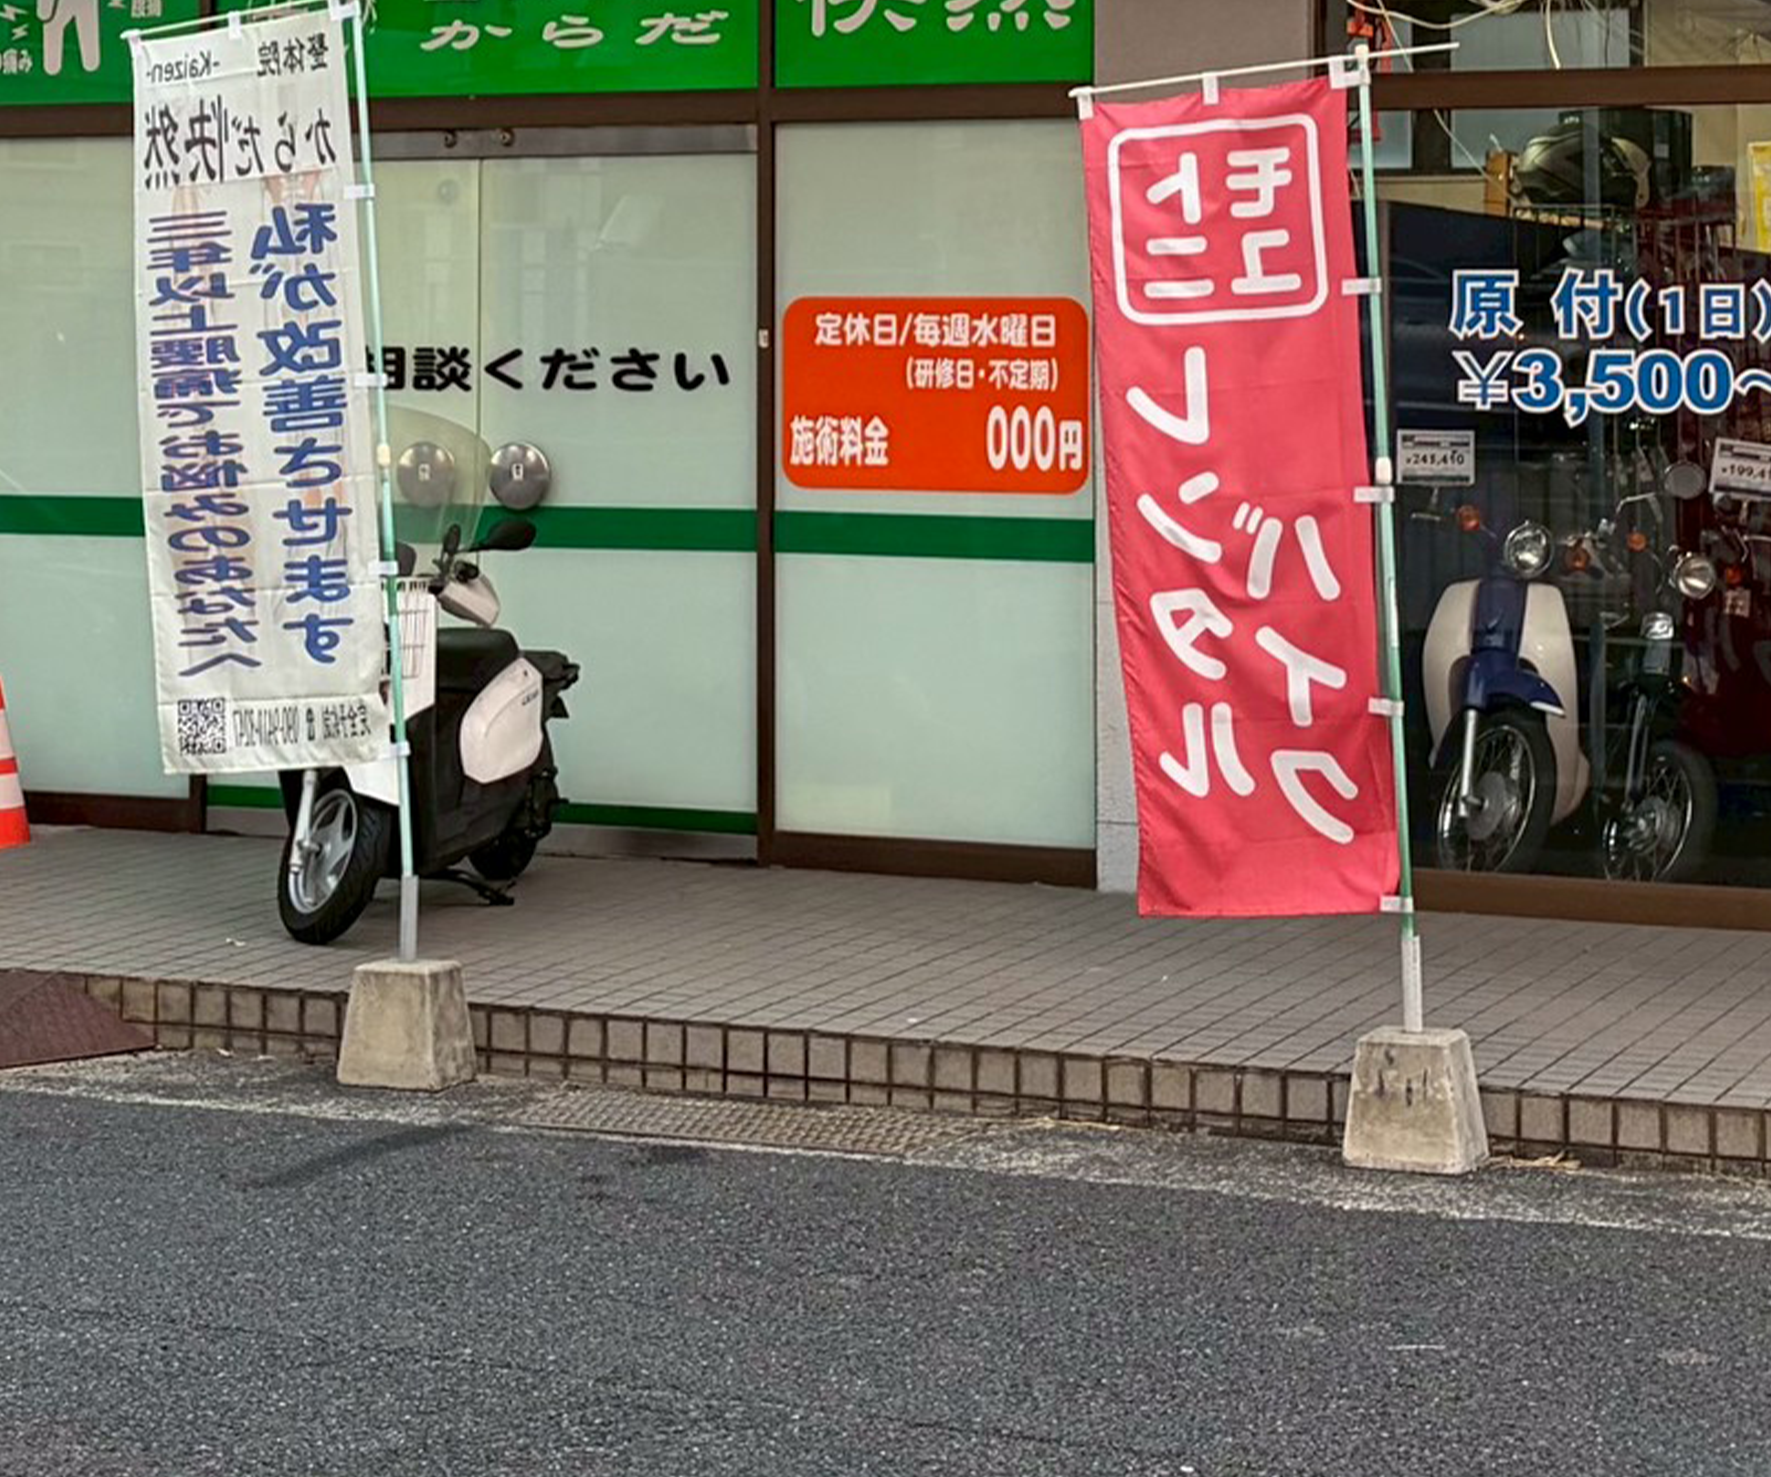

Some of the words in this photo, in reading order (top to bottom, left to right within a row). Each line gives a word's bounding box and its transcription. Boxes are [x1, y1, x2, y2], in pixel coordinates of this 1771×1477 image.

[420, 8, 729, 51] からだ
[814, 312, 1057, 348] 定休日/毎週水曜日
[789, 415, 890, 466] 施術料金
[986, 405, 1083, 471] 000円
